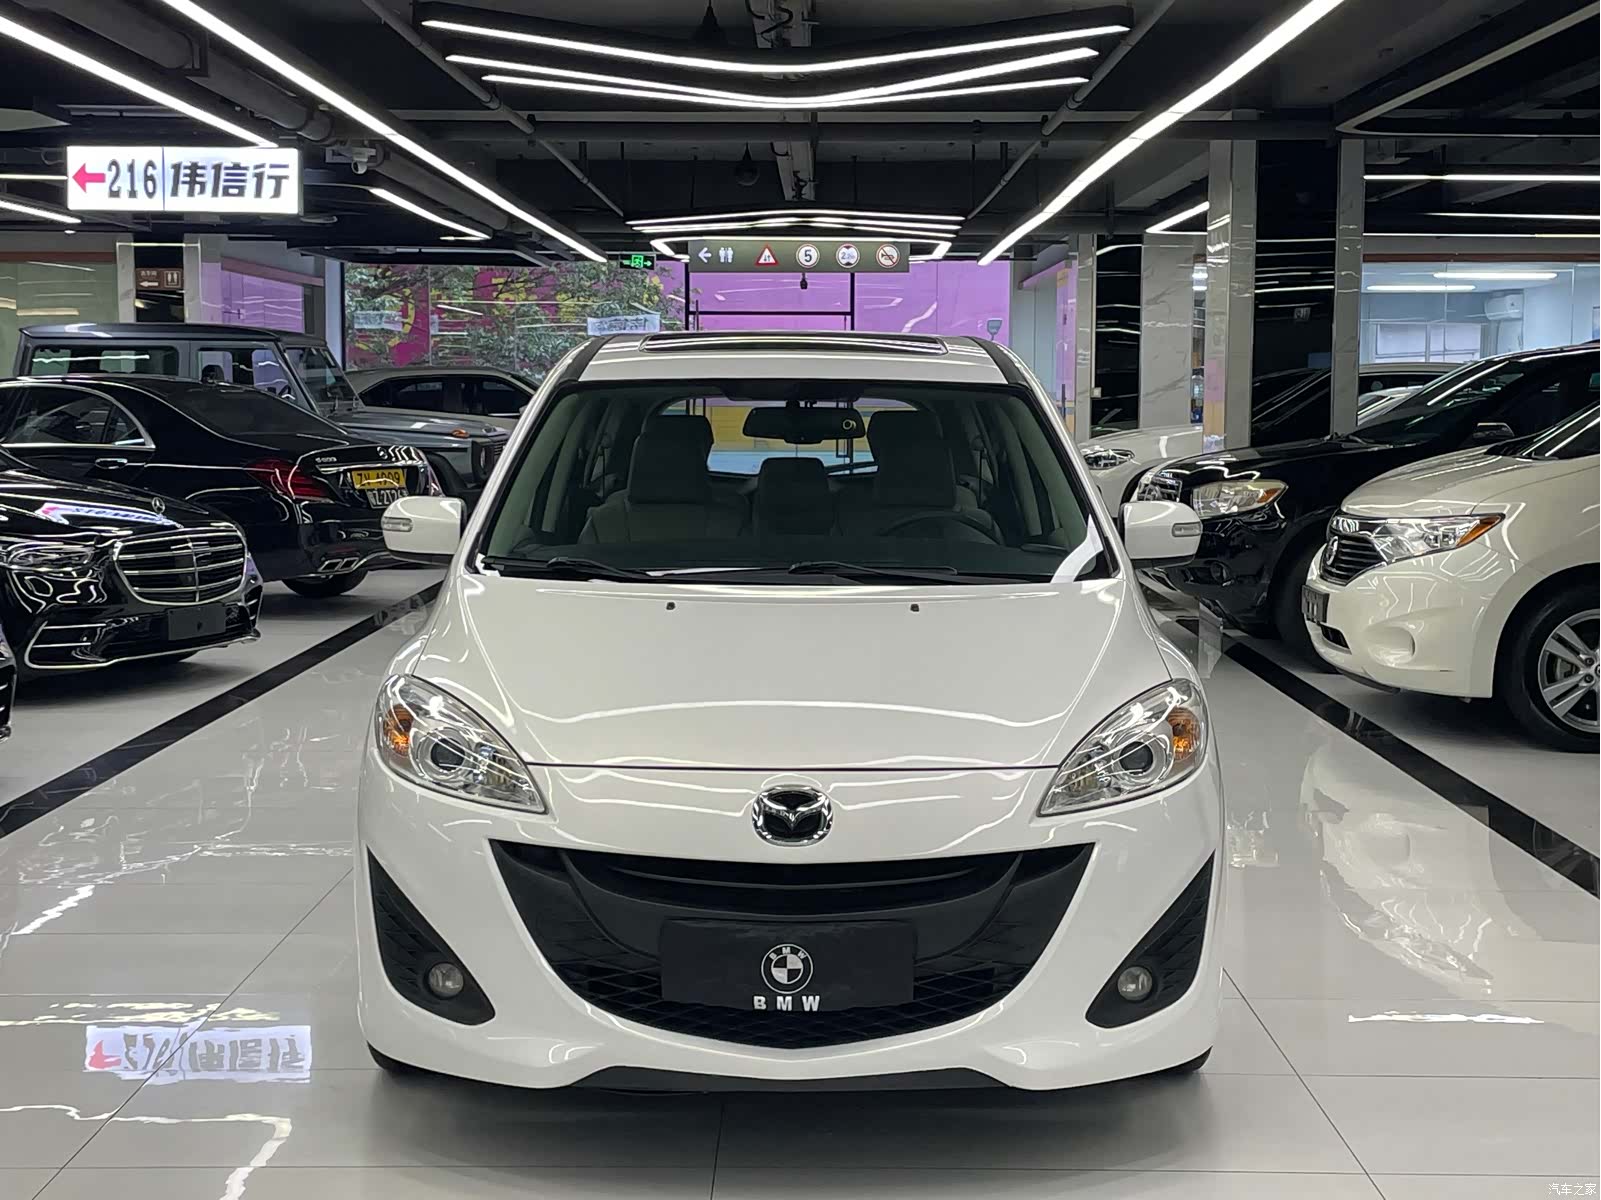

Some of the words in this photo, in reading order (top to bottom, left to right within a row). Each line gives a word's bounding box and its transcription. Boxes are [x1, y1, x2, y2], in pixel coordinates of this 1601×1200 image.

[108, 159, 158, 199] 216
[170, 161, 290, 199] 伟信行
[804, 249, 813, 263] 5
[768, 946, 807, 960] BMW
[753, 995, 820, 1012] BMW
